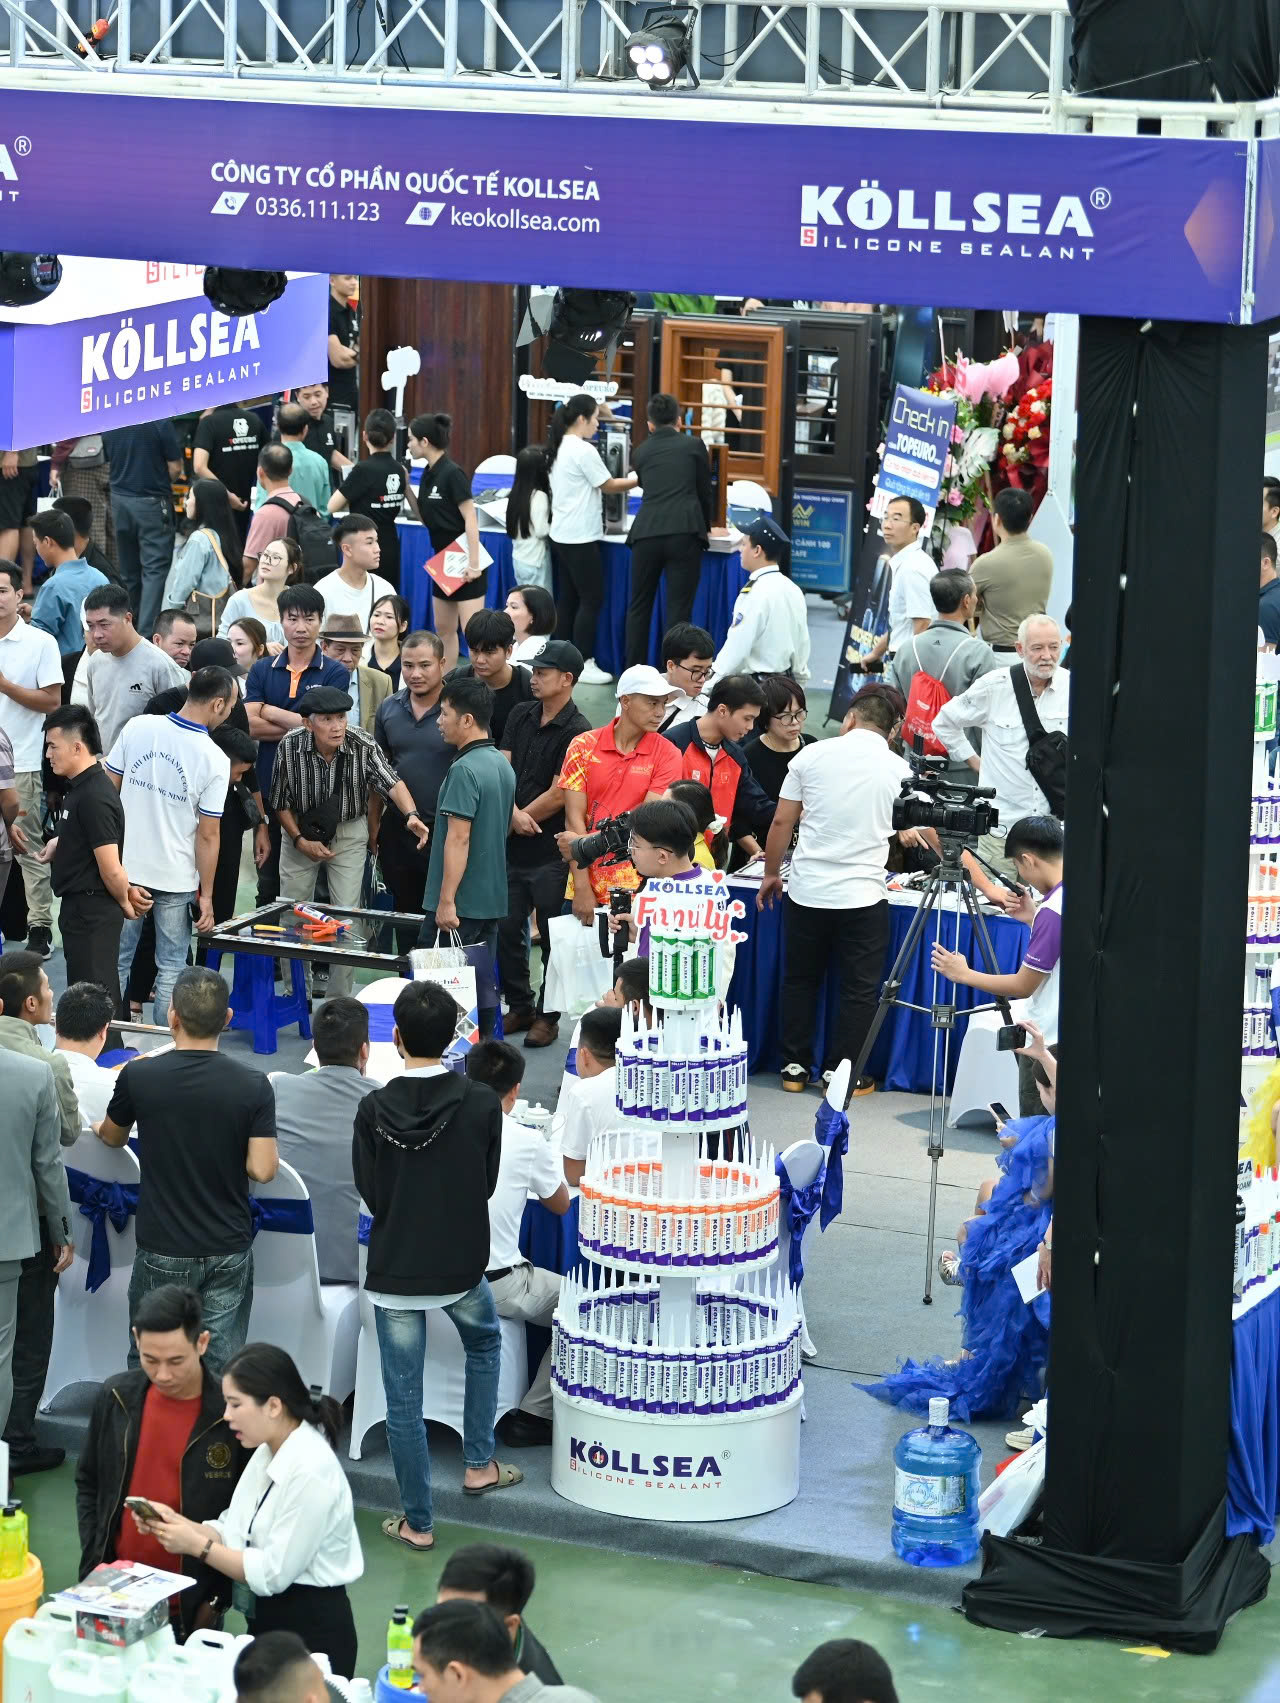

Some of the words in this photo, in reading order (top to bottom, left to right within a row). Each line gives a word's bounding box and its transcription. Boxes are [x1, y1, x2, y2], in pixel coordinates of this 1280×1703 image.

[211, 159, 270, 184] CÔNG
[274, 165, 301, 186] TY
[305, 162, 335, 188] CỔ
[340, 165, 400, 191] PHẦN
[405, 168, 468, 195] QUỐC
[473, 170, 500, 196] TẾ
[504, 176, 600, 201] KOLLSEA
[255, 196, 380, 222] 0336.111.123
[450, 205, 600, 233] keokollsea.com
[801, 180, 1094, 237] KÖLLSEA
[801, 226, 942, 253] SILICONE
[960, 242, 1094, 260] SEALANT
[81, 381, 172, 413] SILICONE
[182, 362, 260, 392] SEALANT
[893, 397, 936, 434] Check
[937, 416, 949, 439] in
[897, 433, 936, 462] TOPEURO
[649, 880, 726, 896] KÖLLSEA
[570, 1437, 722, 1478] KÖLLSEA
[645, 1481, 722, 1489] SEALANT
